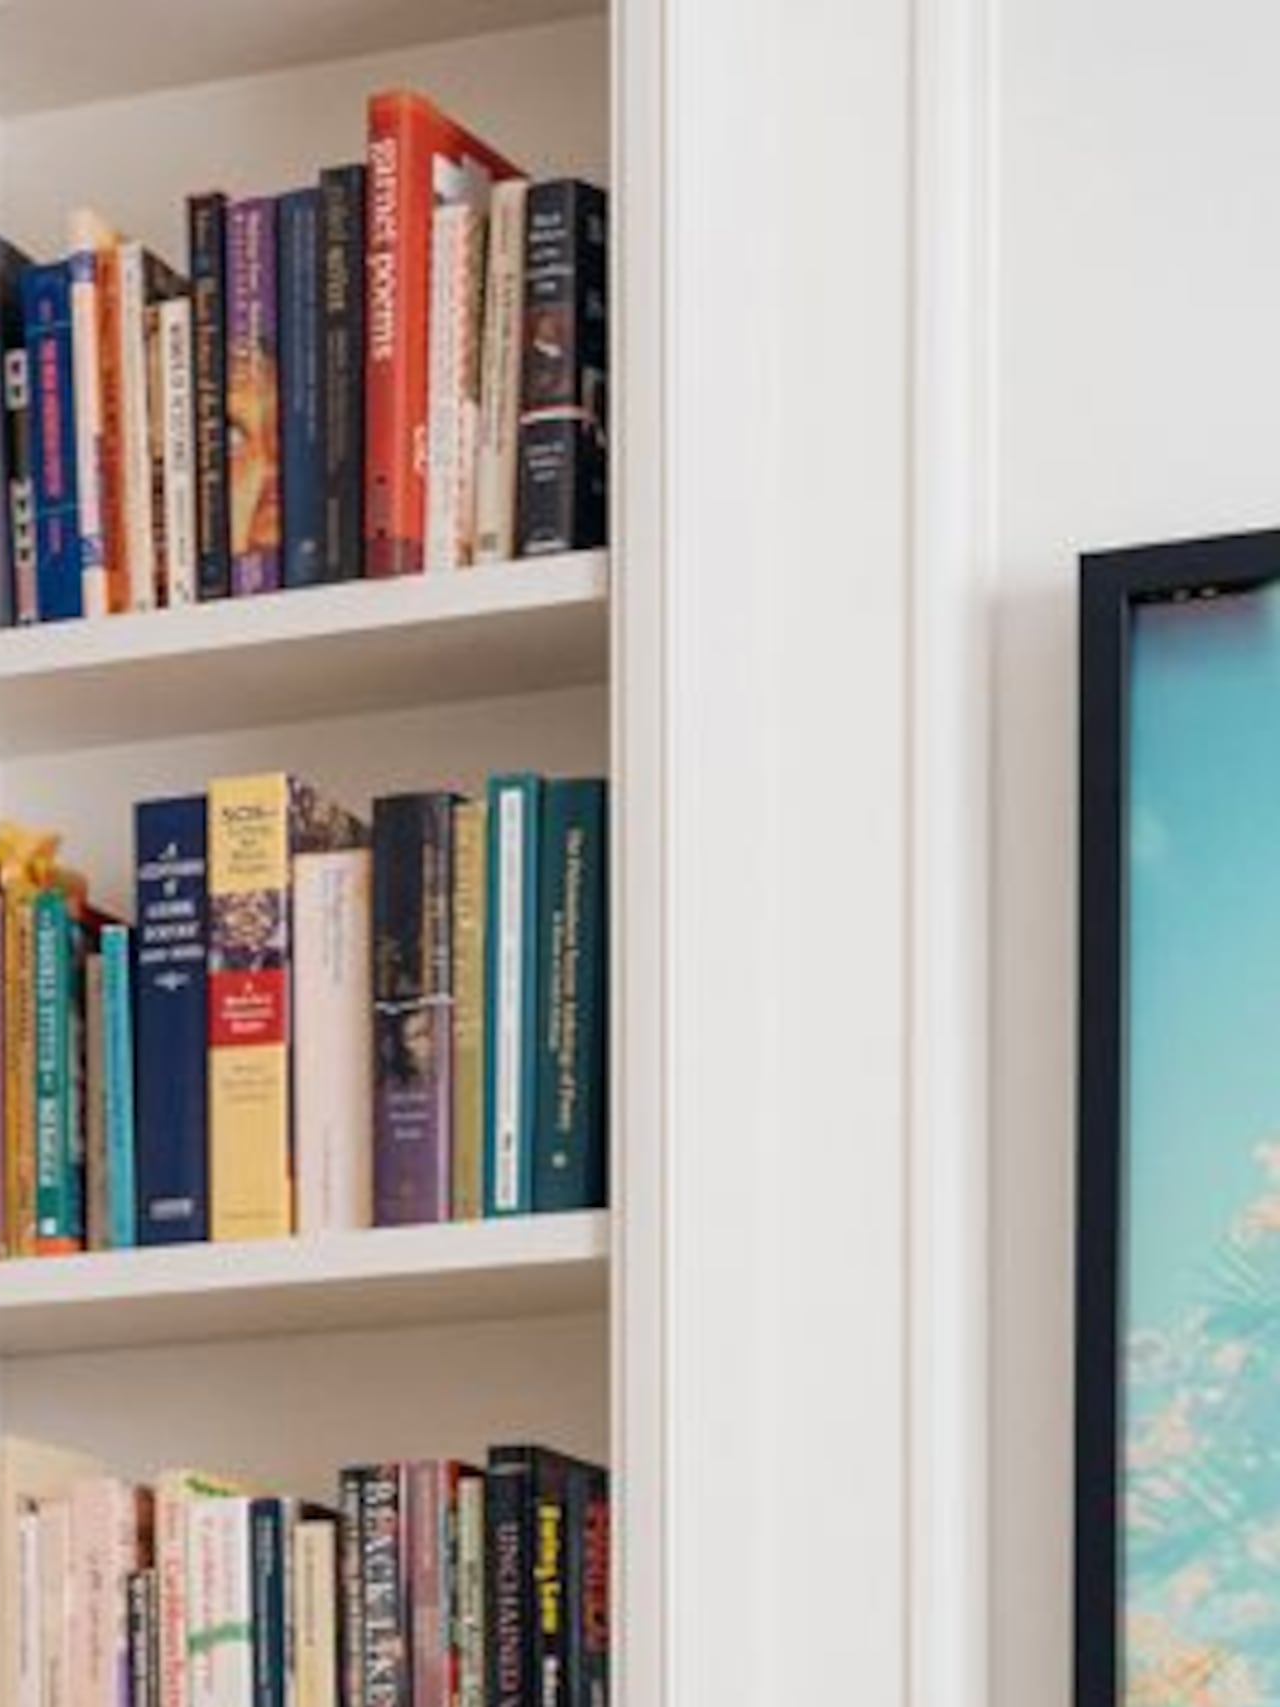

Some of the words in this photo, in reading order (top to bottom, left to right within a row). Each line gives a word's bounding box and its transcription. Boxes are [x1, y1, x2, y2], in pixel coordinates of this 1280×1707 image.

[368, 253, 397, 360] poems
[365, 1481, 392, 1608] BLACK
[498, 1522, 518, 1692] UNCHAINED
